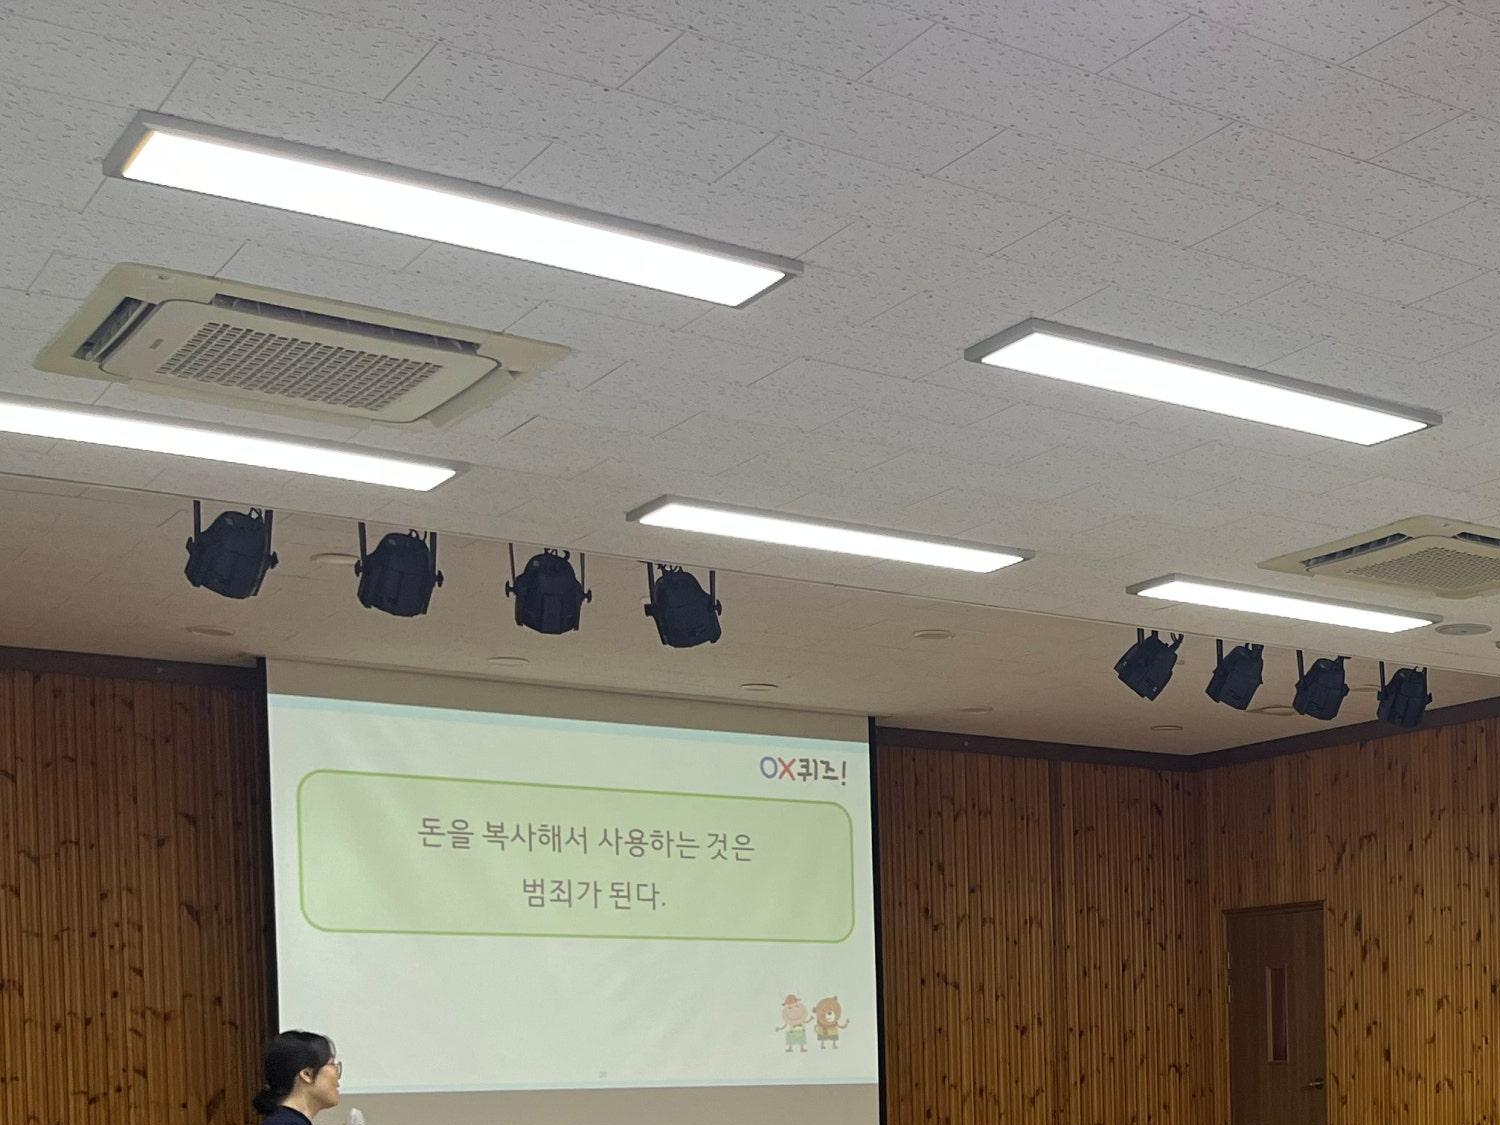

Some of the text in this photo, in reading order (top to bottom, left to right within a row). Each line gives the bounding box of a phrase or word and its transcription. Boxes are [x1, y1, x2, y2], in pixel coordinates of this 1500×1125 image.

[760, 756, 846, 786] OX퀴즈!
[418, 817, 756, 863] 돈을 복사해서 사용하는 것은
[522, 878, 667, 911] 범죄가 된다.
